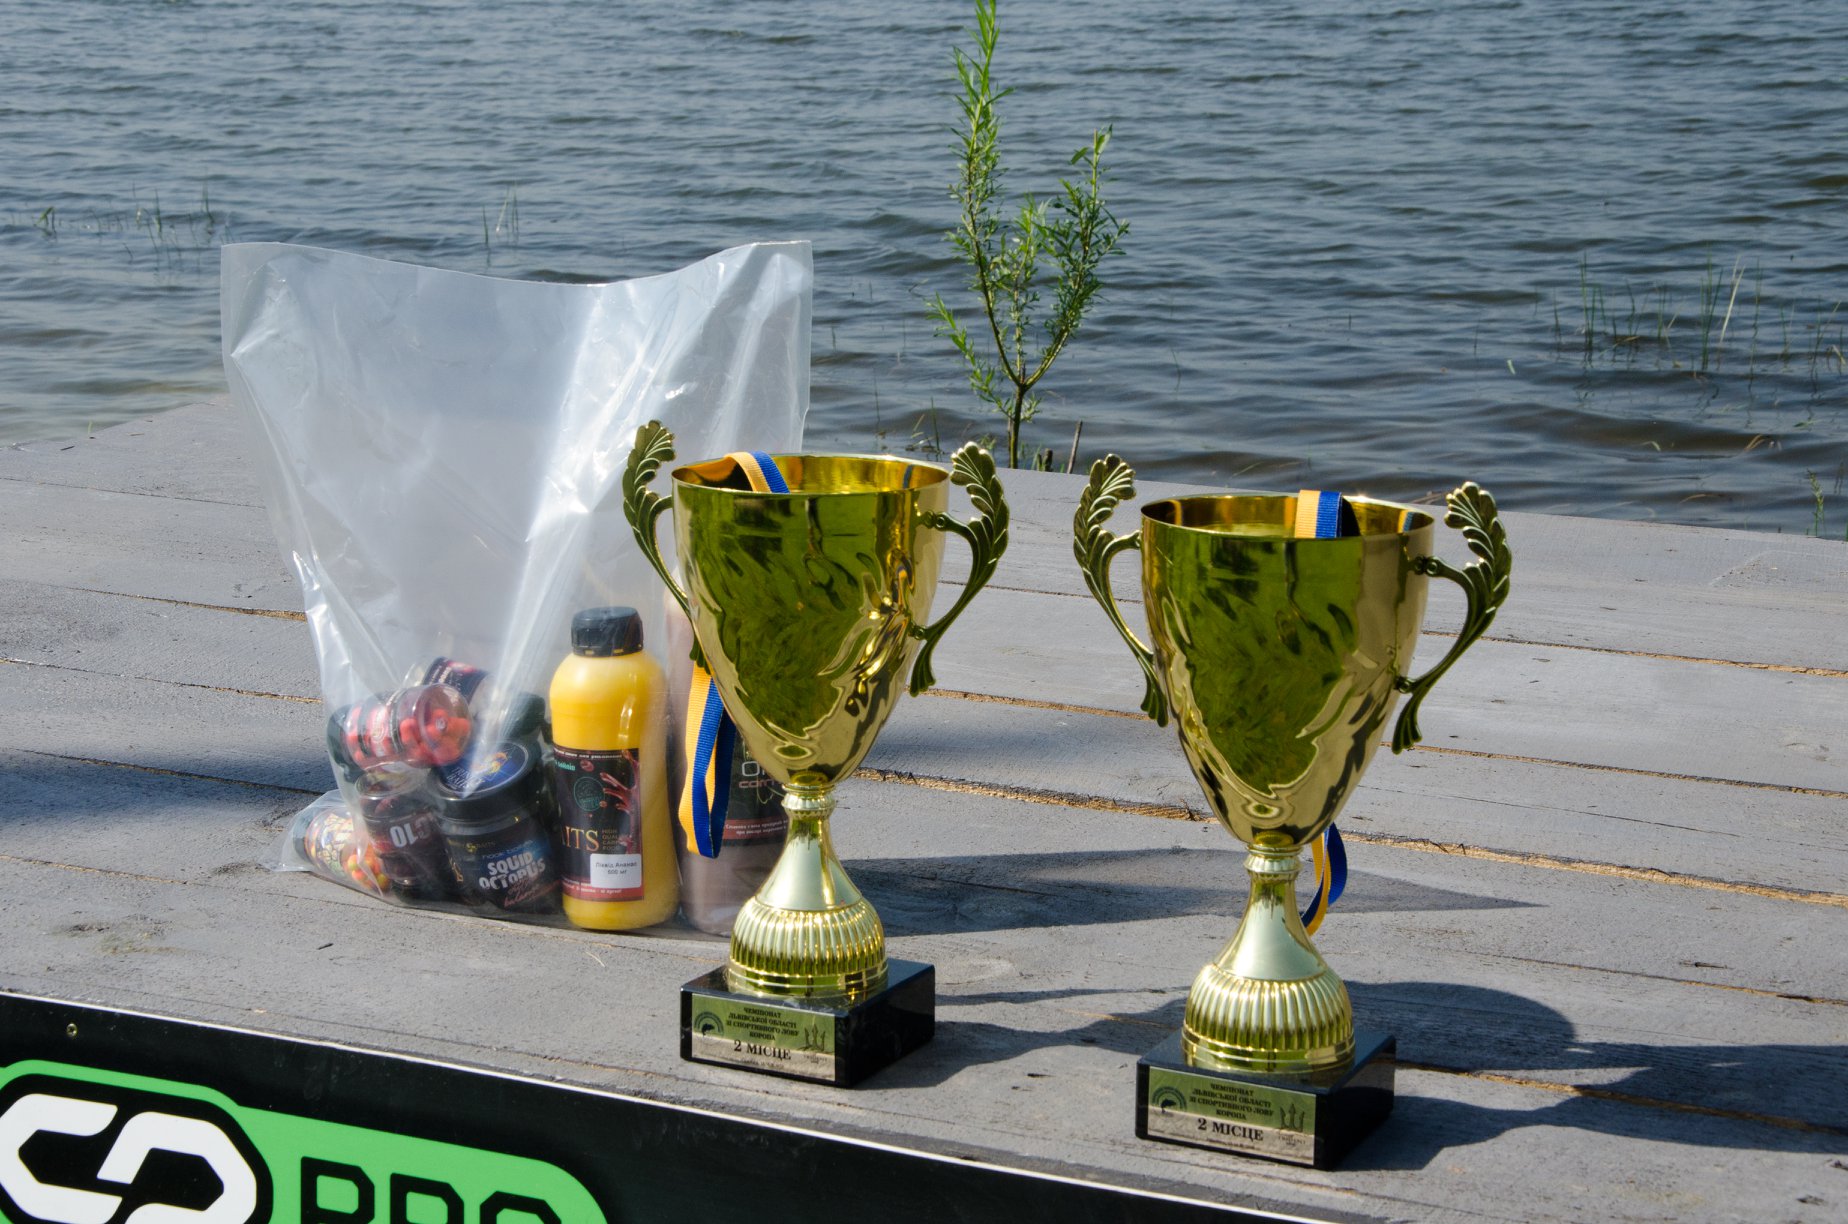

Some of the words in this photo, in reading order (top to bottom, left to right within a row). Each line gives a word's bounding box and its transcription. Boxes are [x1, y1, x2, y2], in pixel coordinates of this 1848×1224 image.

[479, 858, 546, 890] OCTOPUS
[487, 852, 534, 876] SQUID
[734, 1039, 742, 1052] 2
[746, 1043, 791, 1061] МІСЦЕ
[1198, 1117, 1207, 1131] 2
[1212, 1121, 1264, 1142] МІСЦЕ
